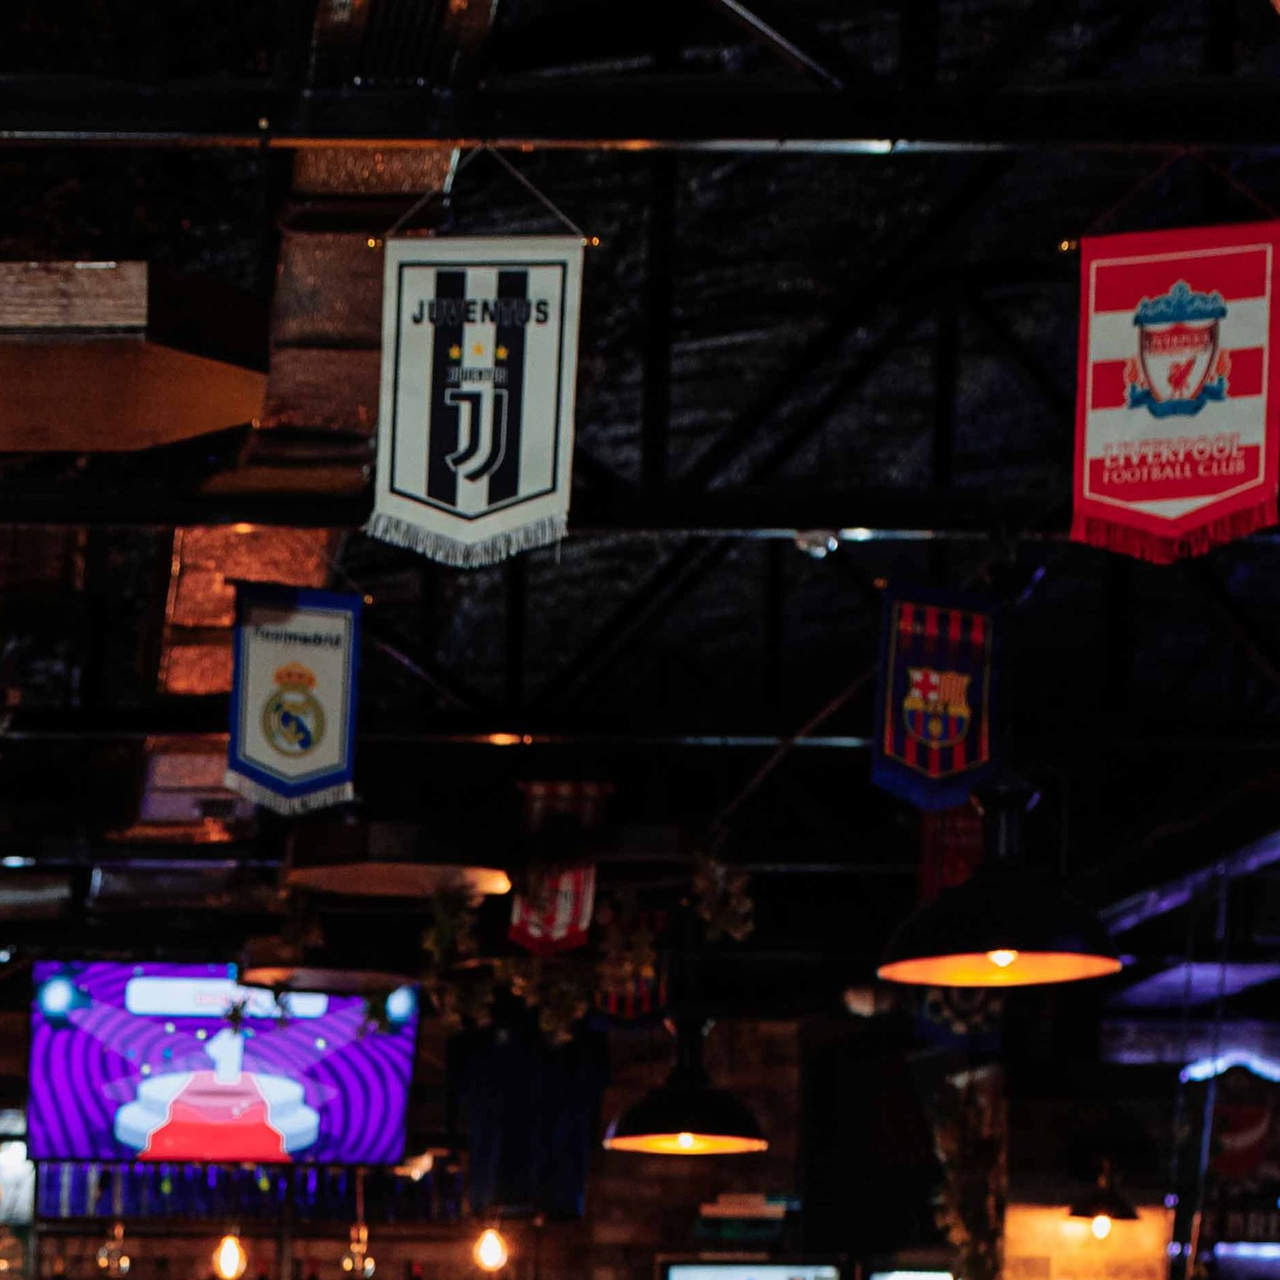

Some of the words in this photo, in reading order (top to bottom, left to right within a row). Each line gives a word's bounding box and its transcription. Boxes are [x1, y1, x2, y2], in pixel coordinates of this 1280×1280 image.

[412, 299, 550, 325] JUVENTUS
[1103, 432, 1245, 469] LIVERPOOL
[1102, 463, 1192, 485] FOOTBALL
[1197, 457, 1246, 477] CLUB
